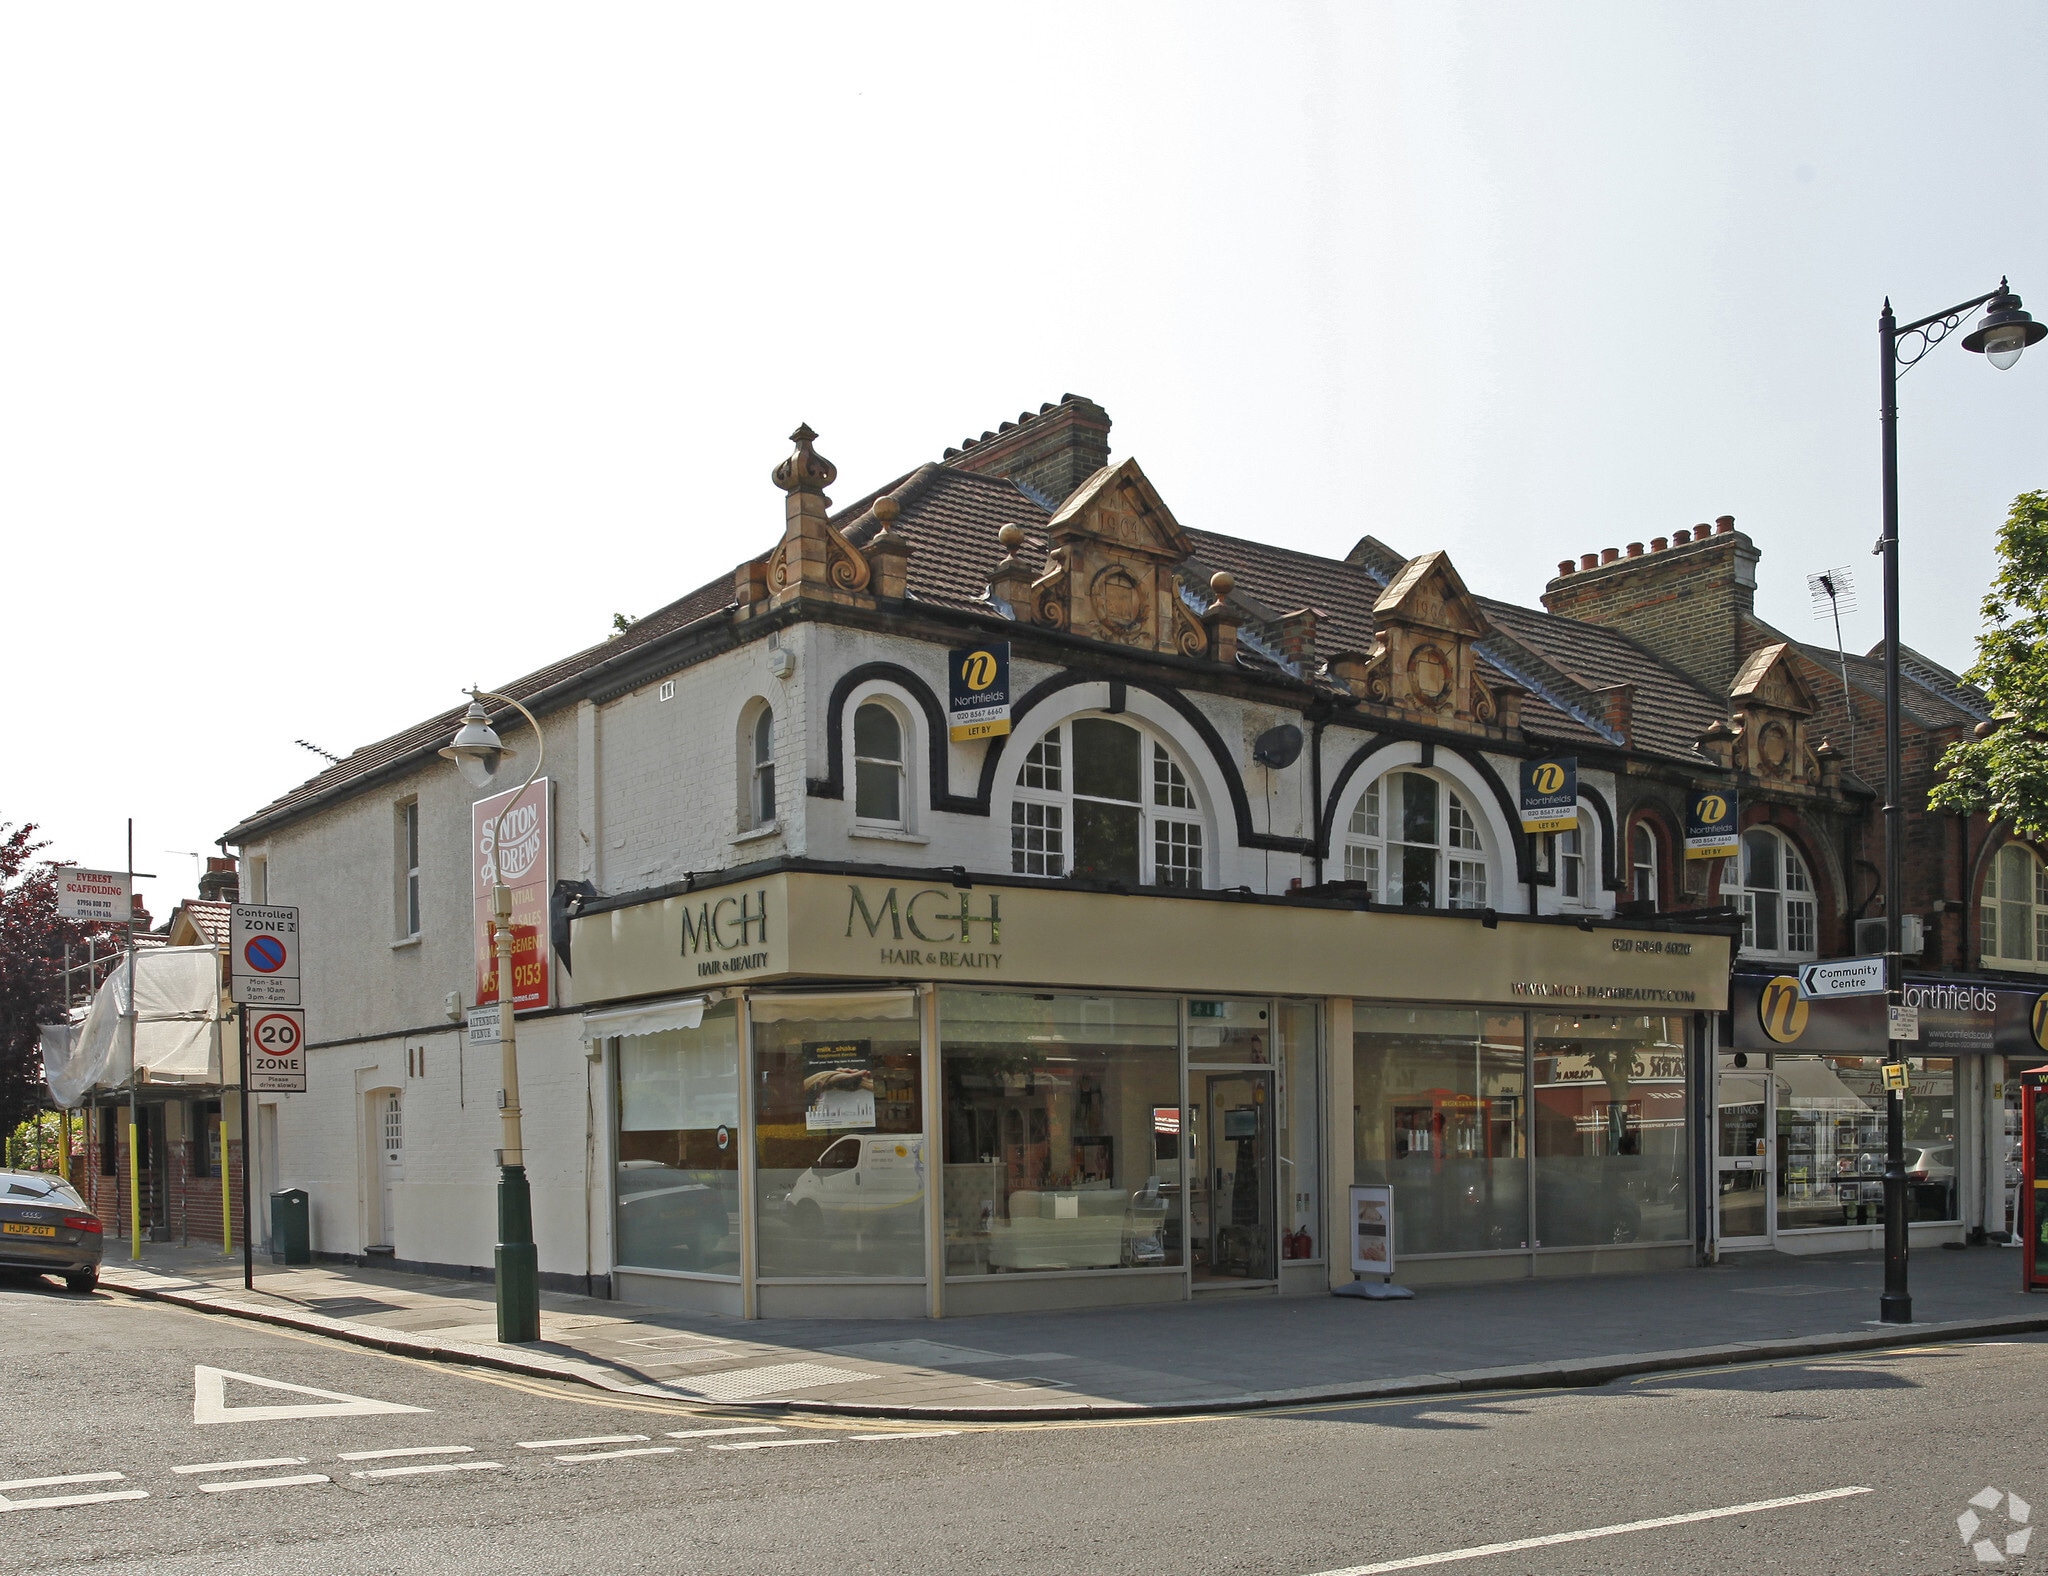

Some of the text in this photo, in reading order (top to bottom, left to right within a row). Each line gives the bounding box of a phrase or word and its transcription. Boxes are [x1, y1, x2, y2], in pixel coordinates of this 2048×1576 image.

[1100, 513, 1138, 541] 1904
[954, 690, 1004, 706] Northfields
[956, 707, 1003, 720] 020 8567 6660
[968, 725, 991, 736] LET BY
[1525, 795, 1572, 806] Northfields
[1689, 824, 1733, 835] Northfields
[481, 828, 541, 886] ADREWS
[76, 873, 112, 883] EVEREST
[66, 883, 122, 896] SCAFFOLDING
[236, 908, 293, 920] Controlled
[844, 884, 1002, 945] MCH
[244, 920, 285, 932] ZONE
[680, 889, 766, 957] MCH
[1612, 938, 1632, 952] 020
[1664, 942, 1693, 955] 4020
[698, 951, 769, 977] HAIR & BEAUTY
[880, 948, 1003, 970] HAIR & BEAUTY
[514, 963, 541, 987] 9153
[1820, 965, 1878, 979] Community
[1831, 979, 1866, 989] Centre
[1891, 1009, 1898, 1020] P
[262, 1026, 294, 1044] 20
[470, 1028, 491, 1040] AVENUE
[256, 1058, 299, 1070] ZONE
[1724, 1104, 1759, 1115] LETTINGS
[9, 1224, 50, 1235] HJ12 ZGT
